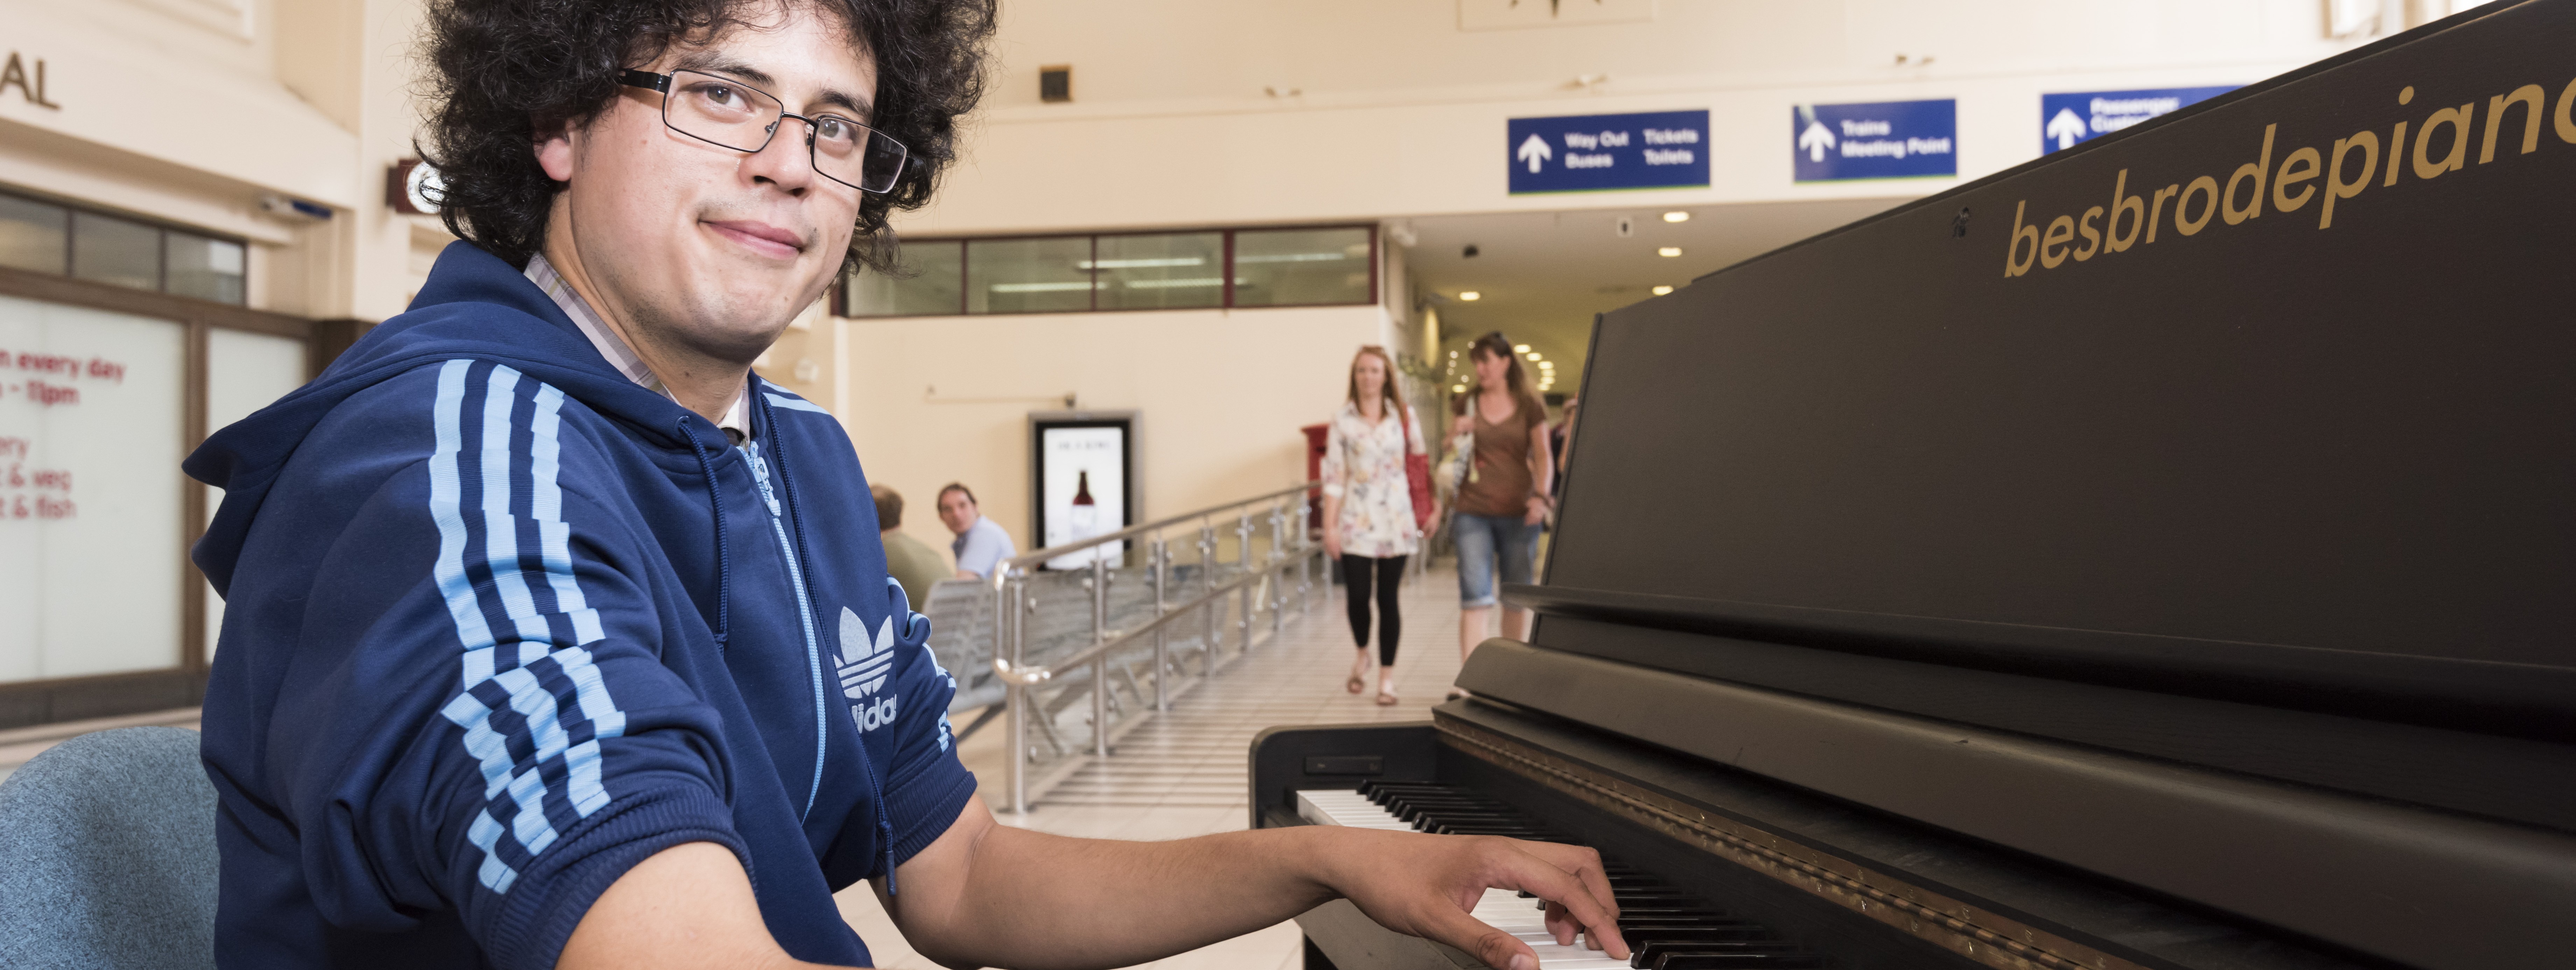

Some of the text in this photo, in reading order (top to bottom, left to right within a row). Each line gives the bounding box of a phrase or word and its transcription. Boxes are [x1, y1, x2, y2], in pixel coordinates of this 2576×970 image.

[2090, 97, 2179, 117] Passenger
[1643, 128, 1699, 145] Tickets
[1840, 120, 1891, 137] Trains
[1564, 131, 1630, 150] Way Out
[1841, 137, 1951, 159] Meeting Point
[1565, 152, 1614, 169] Buses
[1643, 149, 1694, 165] Toilets
[16, 353, 81, 381] every
[87, 357, 127, 384] day
[26, 380, 81, 408] 11pm
[32, 471, 72, 494] veg
[36, 495, 77, 519] fish
